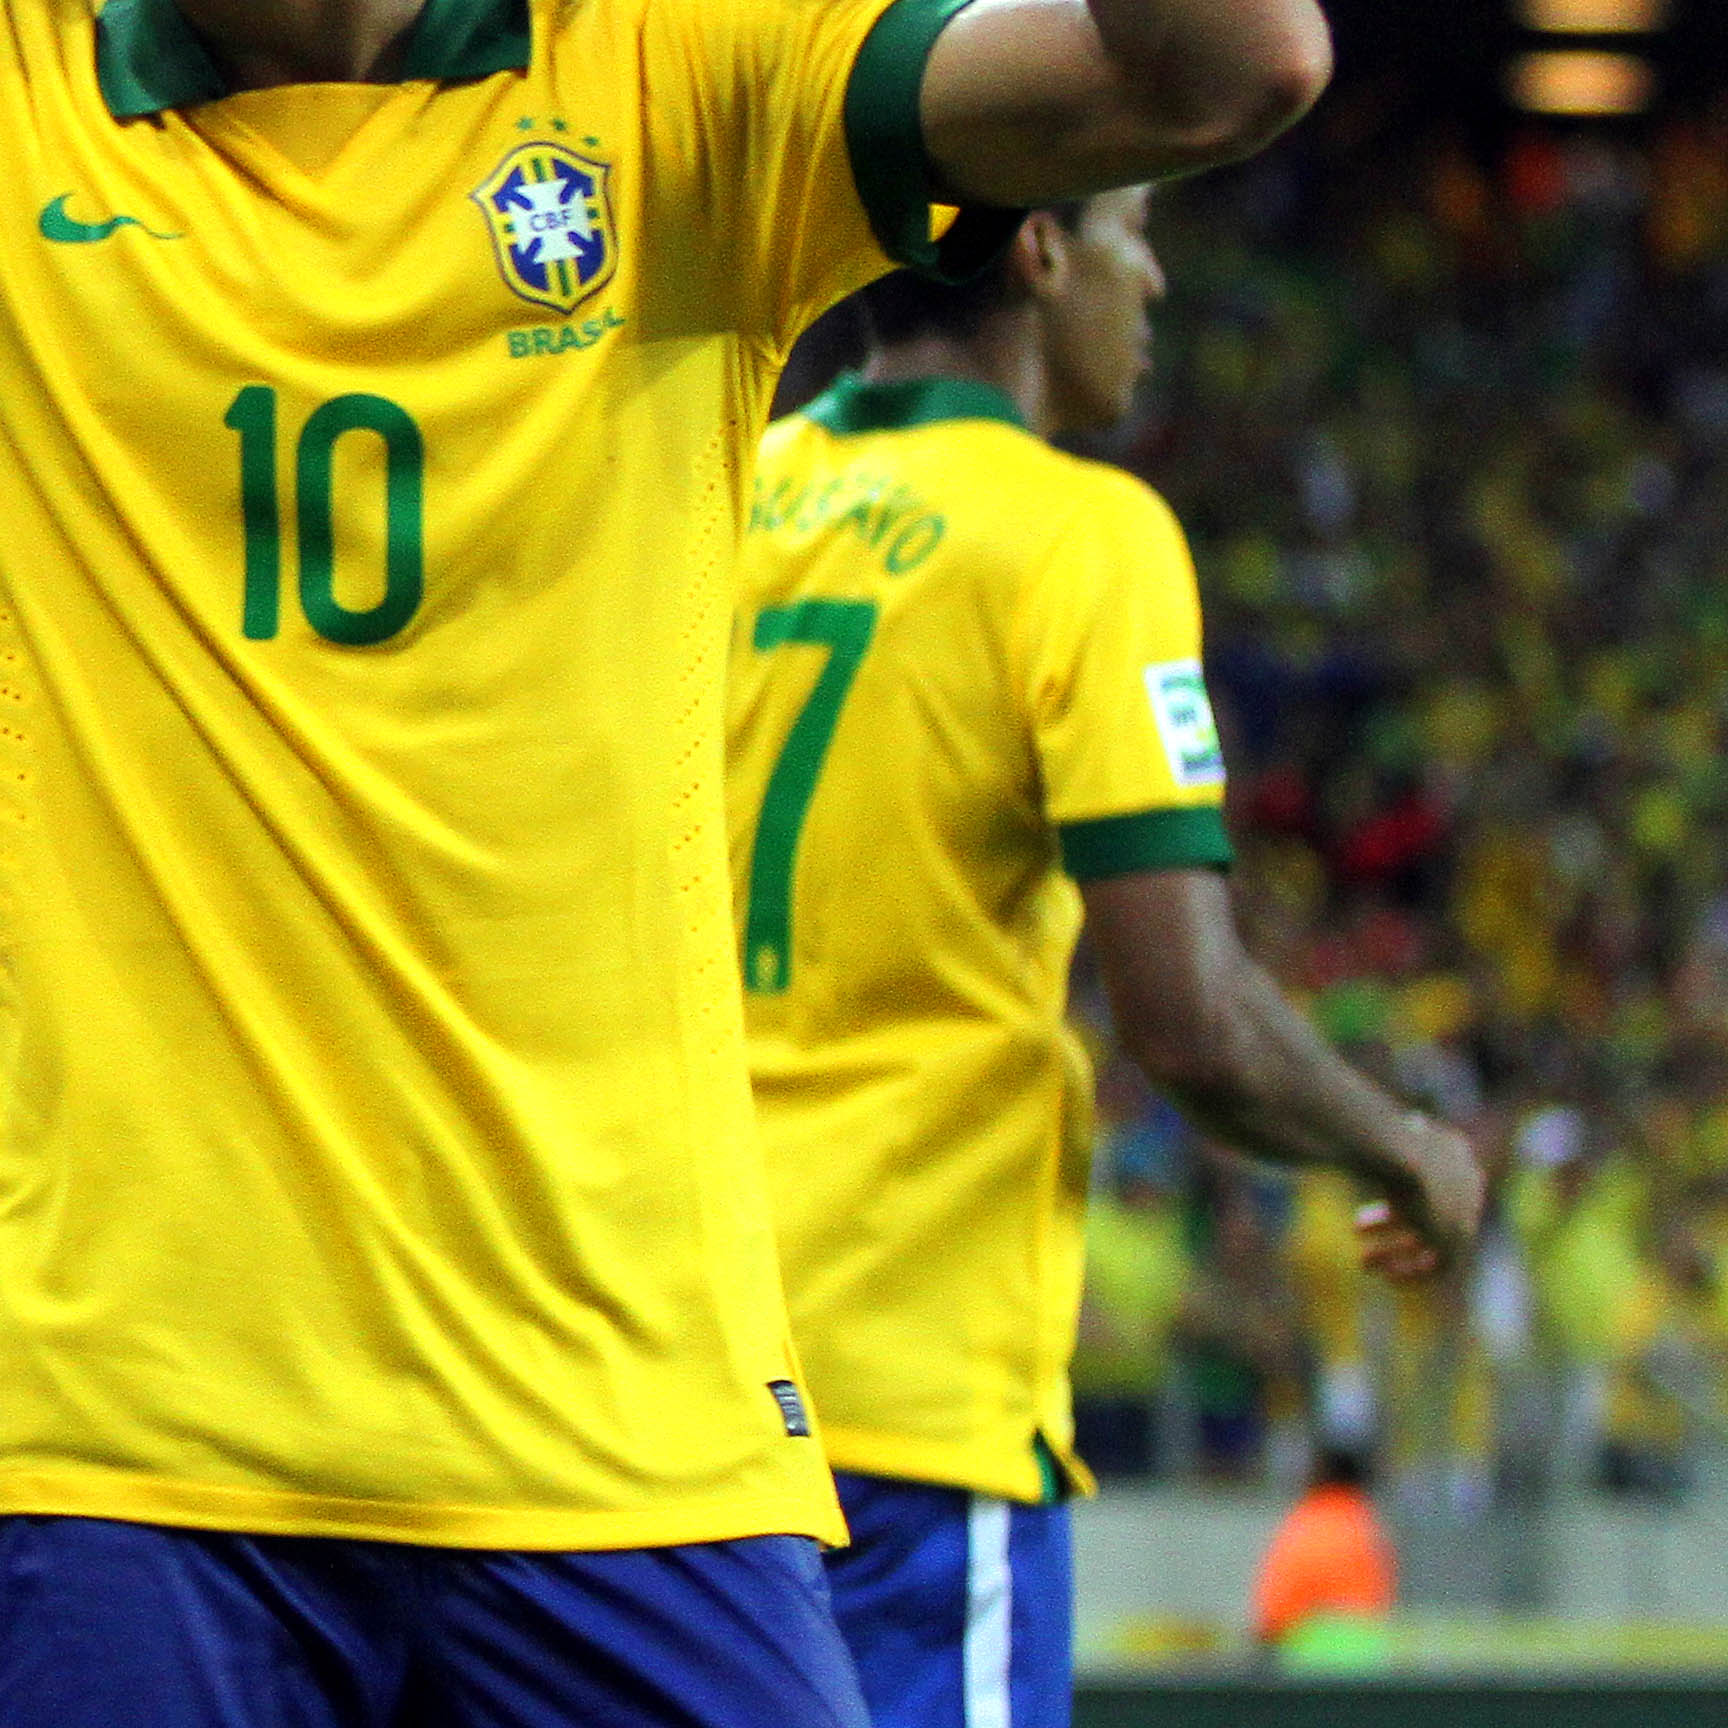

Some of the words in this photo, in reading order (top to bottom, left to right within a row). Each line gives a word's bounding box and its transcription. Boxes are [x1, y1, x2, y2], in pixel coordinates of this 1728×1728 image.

[529, 208, 572, 232] CBF
[507, 307, 627, 358] BRASL
[223, 382, 425, 646] 10
